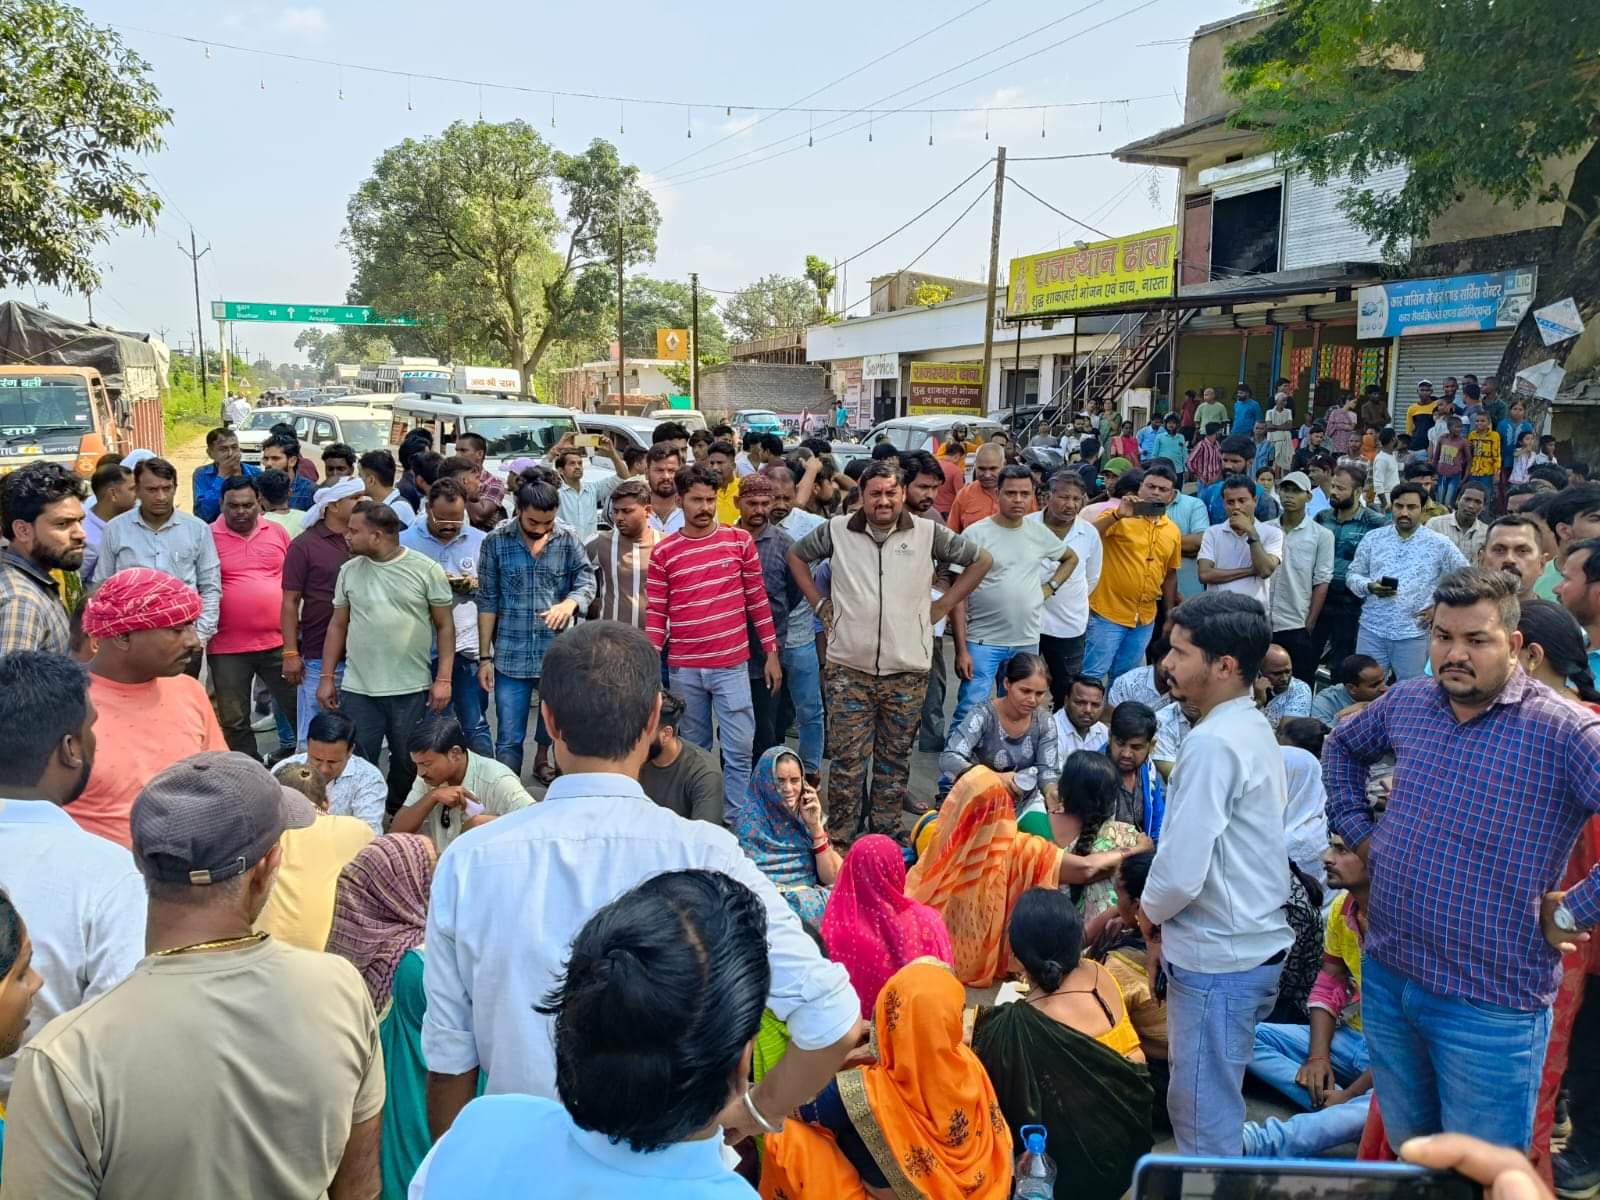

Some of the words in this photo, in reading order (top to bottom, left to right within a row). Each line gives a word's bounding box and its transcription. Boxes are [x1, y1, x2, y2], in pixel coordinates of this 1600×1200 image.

[1035, 246, 1119, 287] राजस्थान
[1124, 235, 1172, 271] ढाबा
[1032, 294, 1045, 312] शुद्ध
[1045, 285, 1079, 306] शाकाहारी
[1080, 281, 1103, 299] भोजन
[1104, 278, 1116, 298] एवं
[1142, 275, 1169, 292] नास्ता
[865, 357, 895, 377] Service
[927, 383, 957, 396] शाकाहारी
